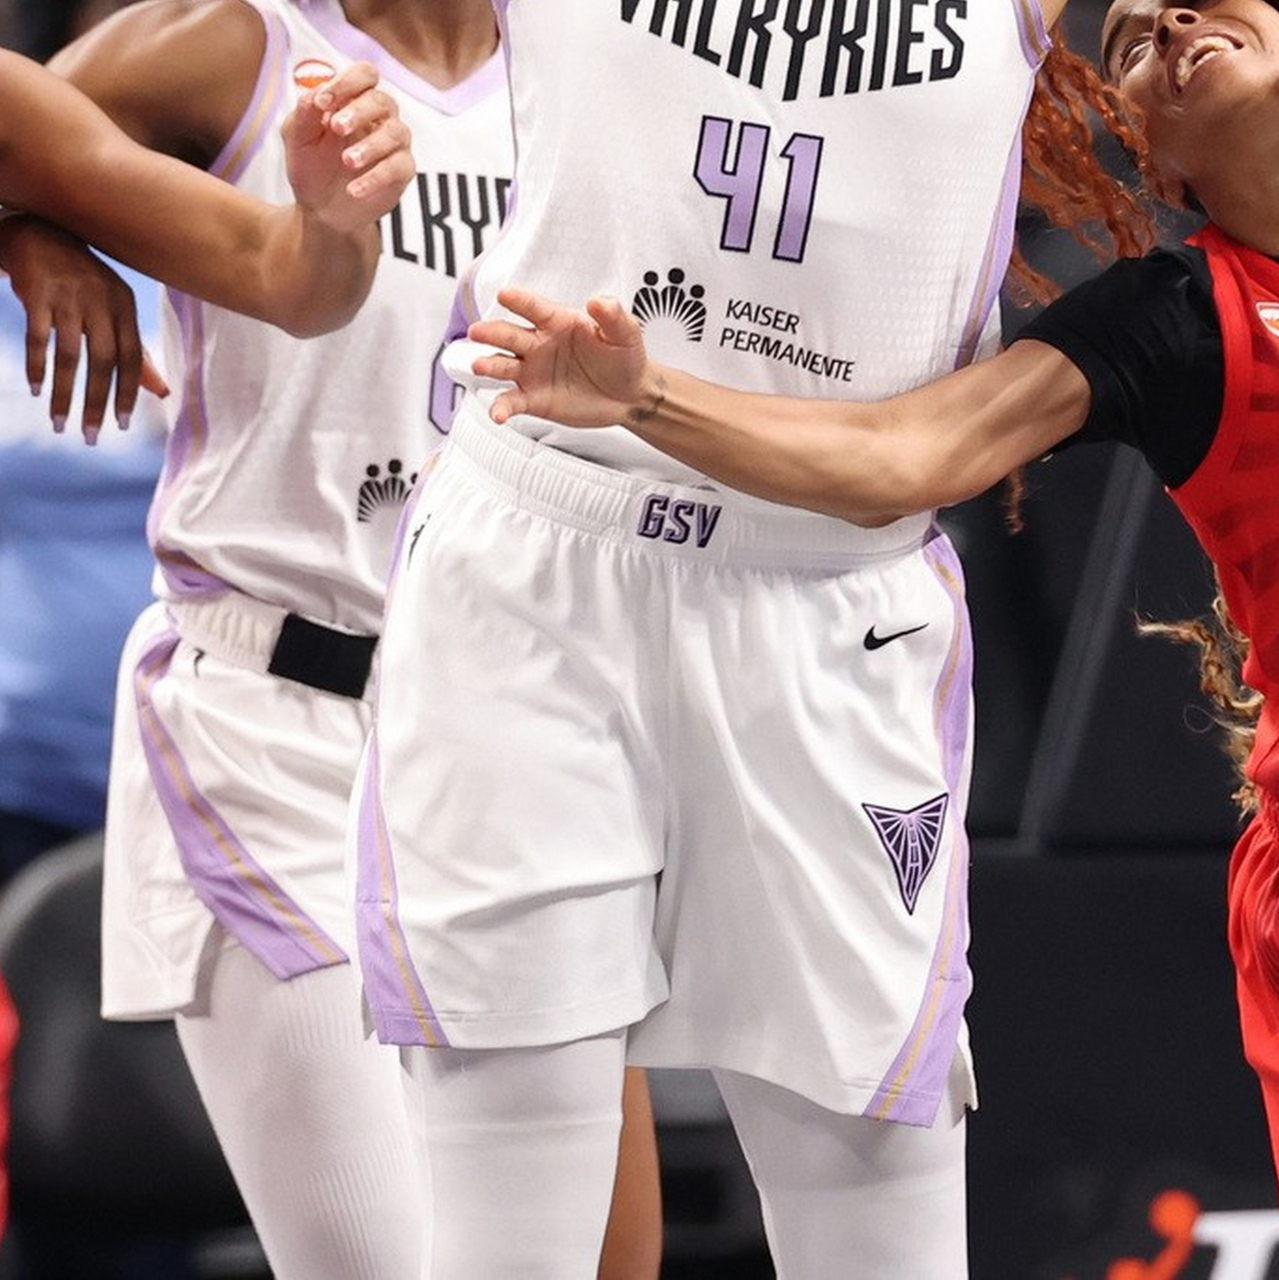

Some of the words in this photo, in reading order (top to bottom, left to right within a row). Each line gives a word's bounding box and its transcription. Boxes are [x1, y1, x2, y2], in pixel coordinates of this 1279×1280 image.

[692, 114, 825, 264] 41
[724, 297, 801, 336] KAISER
[719, 327, 856, 383] PERMANENTE
[637, 493, 722, 549] GSV
